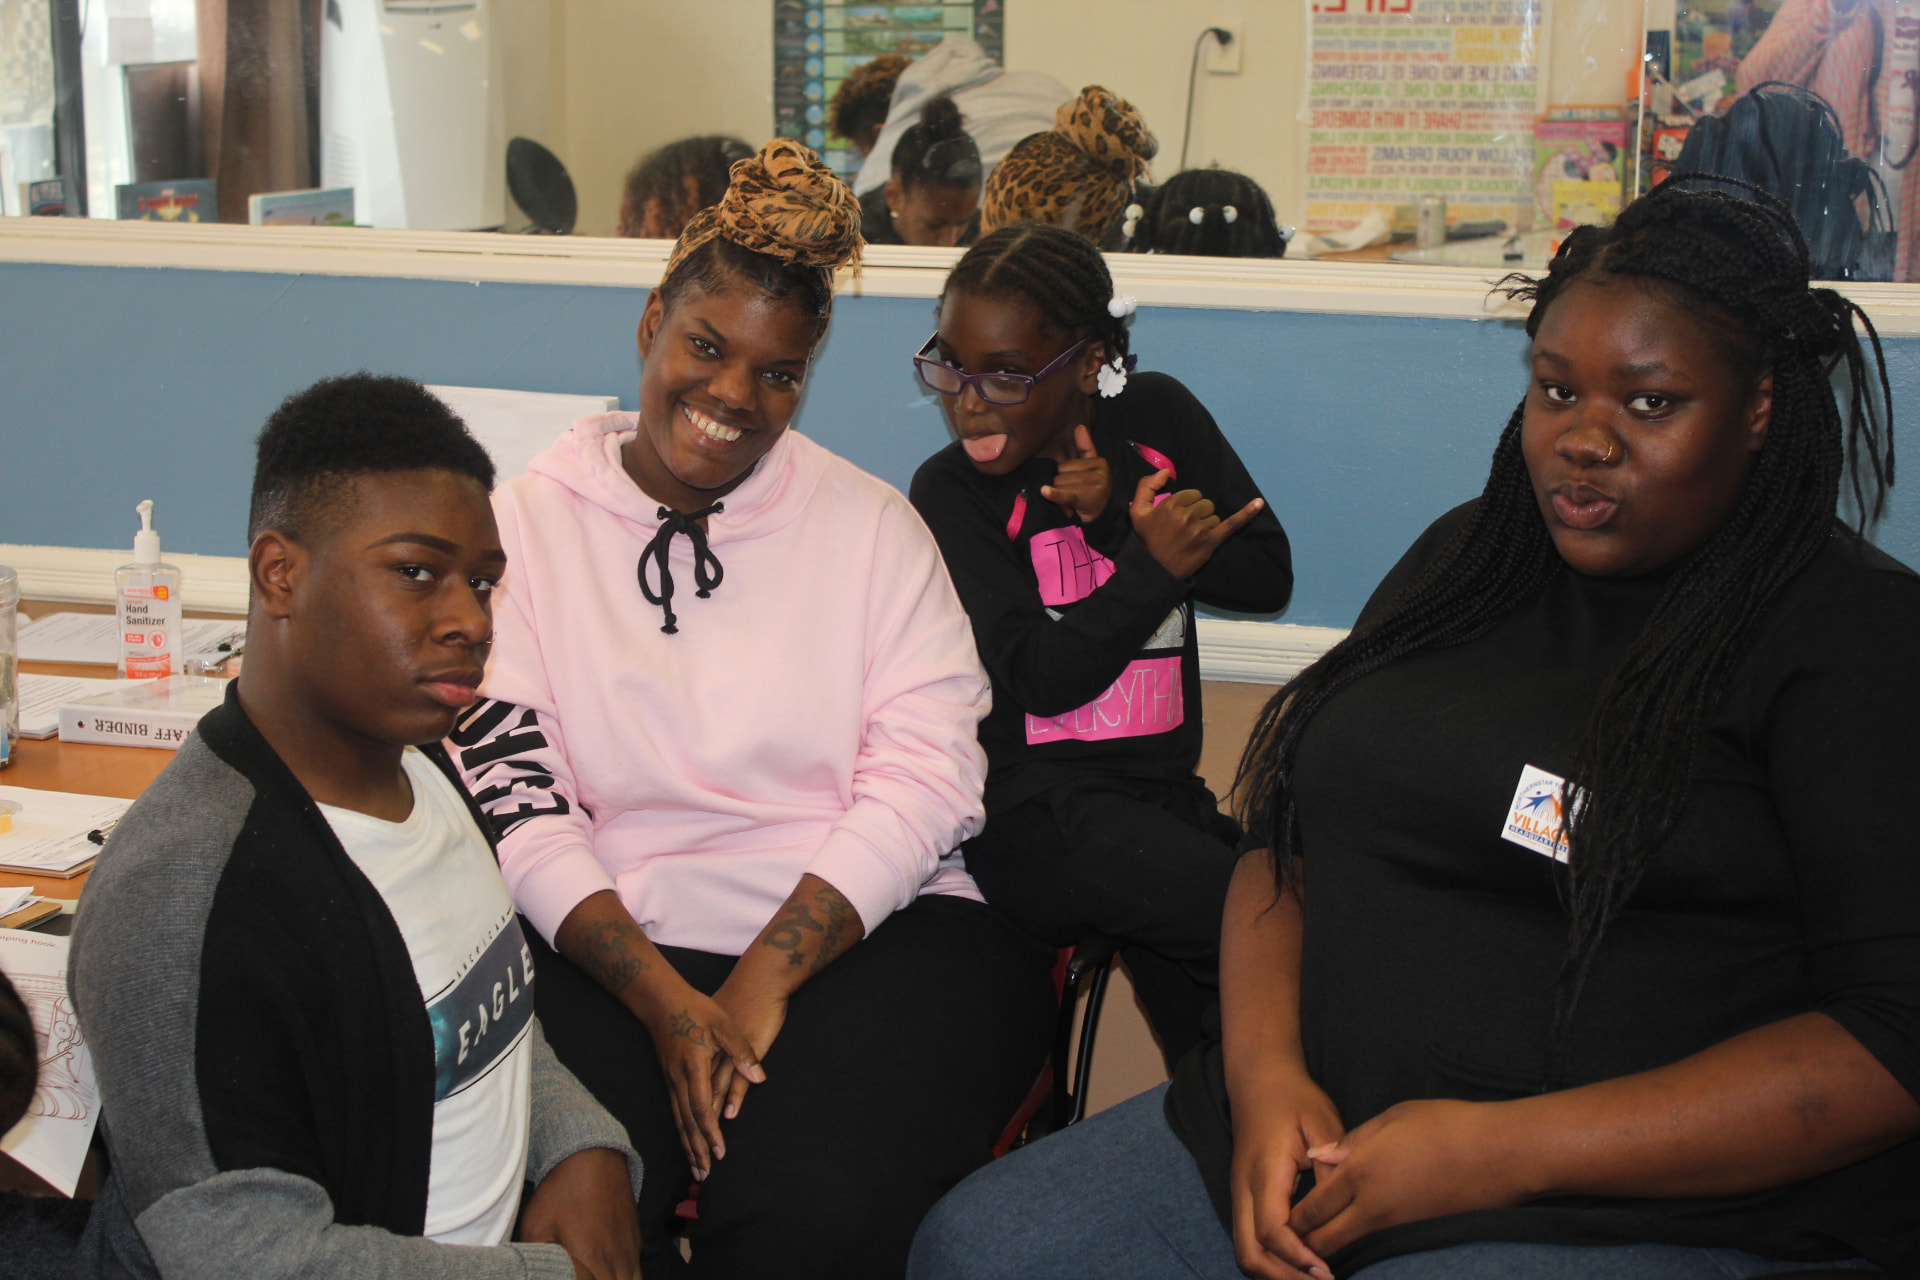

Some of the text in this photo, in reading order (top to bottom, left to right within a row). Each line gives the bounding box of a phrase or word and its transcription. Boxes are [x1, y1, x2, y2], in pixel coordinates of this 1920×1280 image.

[126, 604, 148, 614] Hand
[126, 616, 166, 626] Sanitizer
[94, 719, 149, 737] BINDER
[457, 942, 535, 1066] EAGLE
